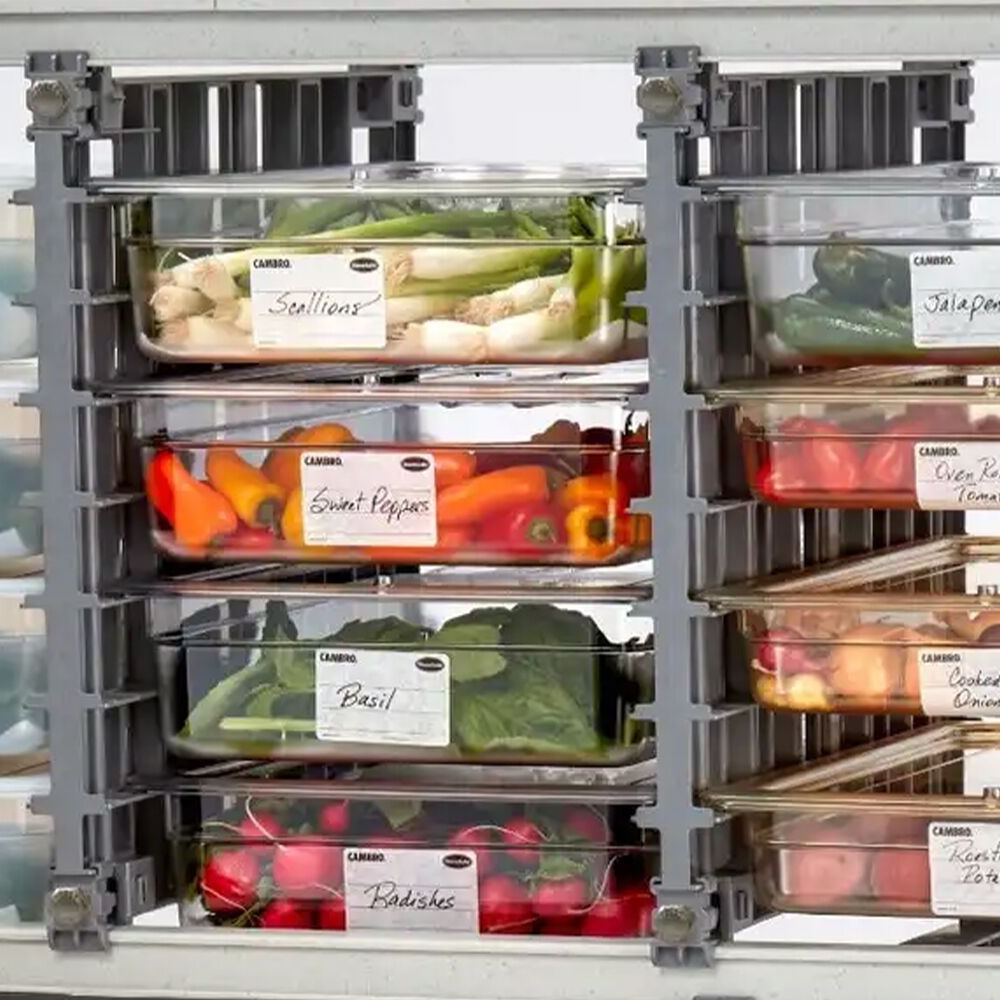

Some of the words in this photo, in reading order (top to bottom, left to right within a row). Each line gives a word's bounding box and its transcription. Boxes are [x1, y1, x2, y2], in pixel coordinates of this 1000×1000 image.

[935, 460, 974, 481] Oven
[978, 456, 1000, 482] Ro
[309, 486, 367, 514] Sweet
[370, 485, 430, 524] Peppers
[953, 482, 1000, 502] Toma
[336, 681, 397, 710] Basil
[363, 881, 455, 910] Radishes
